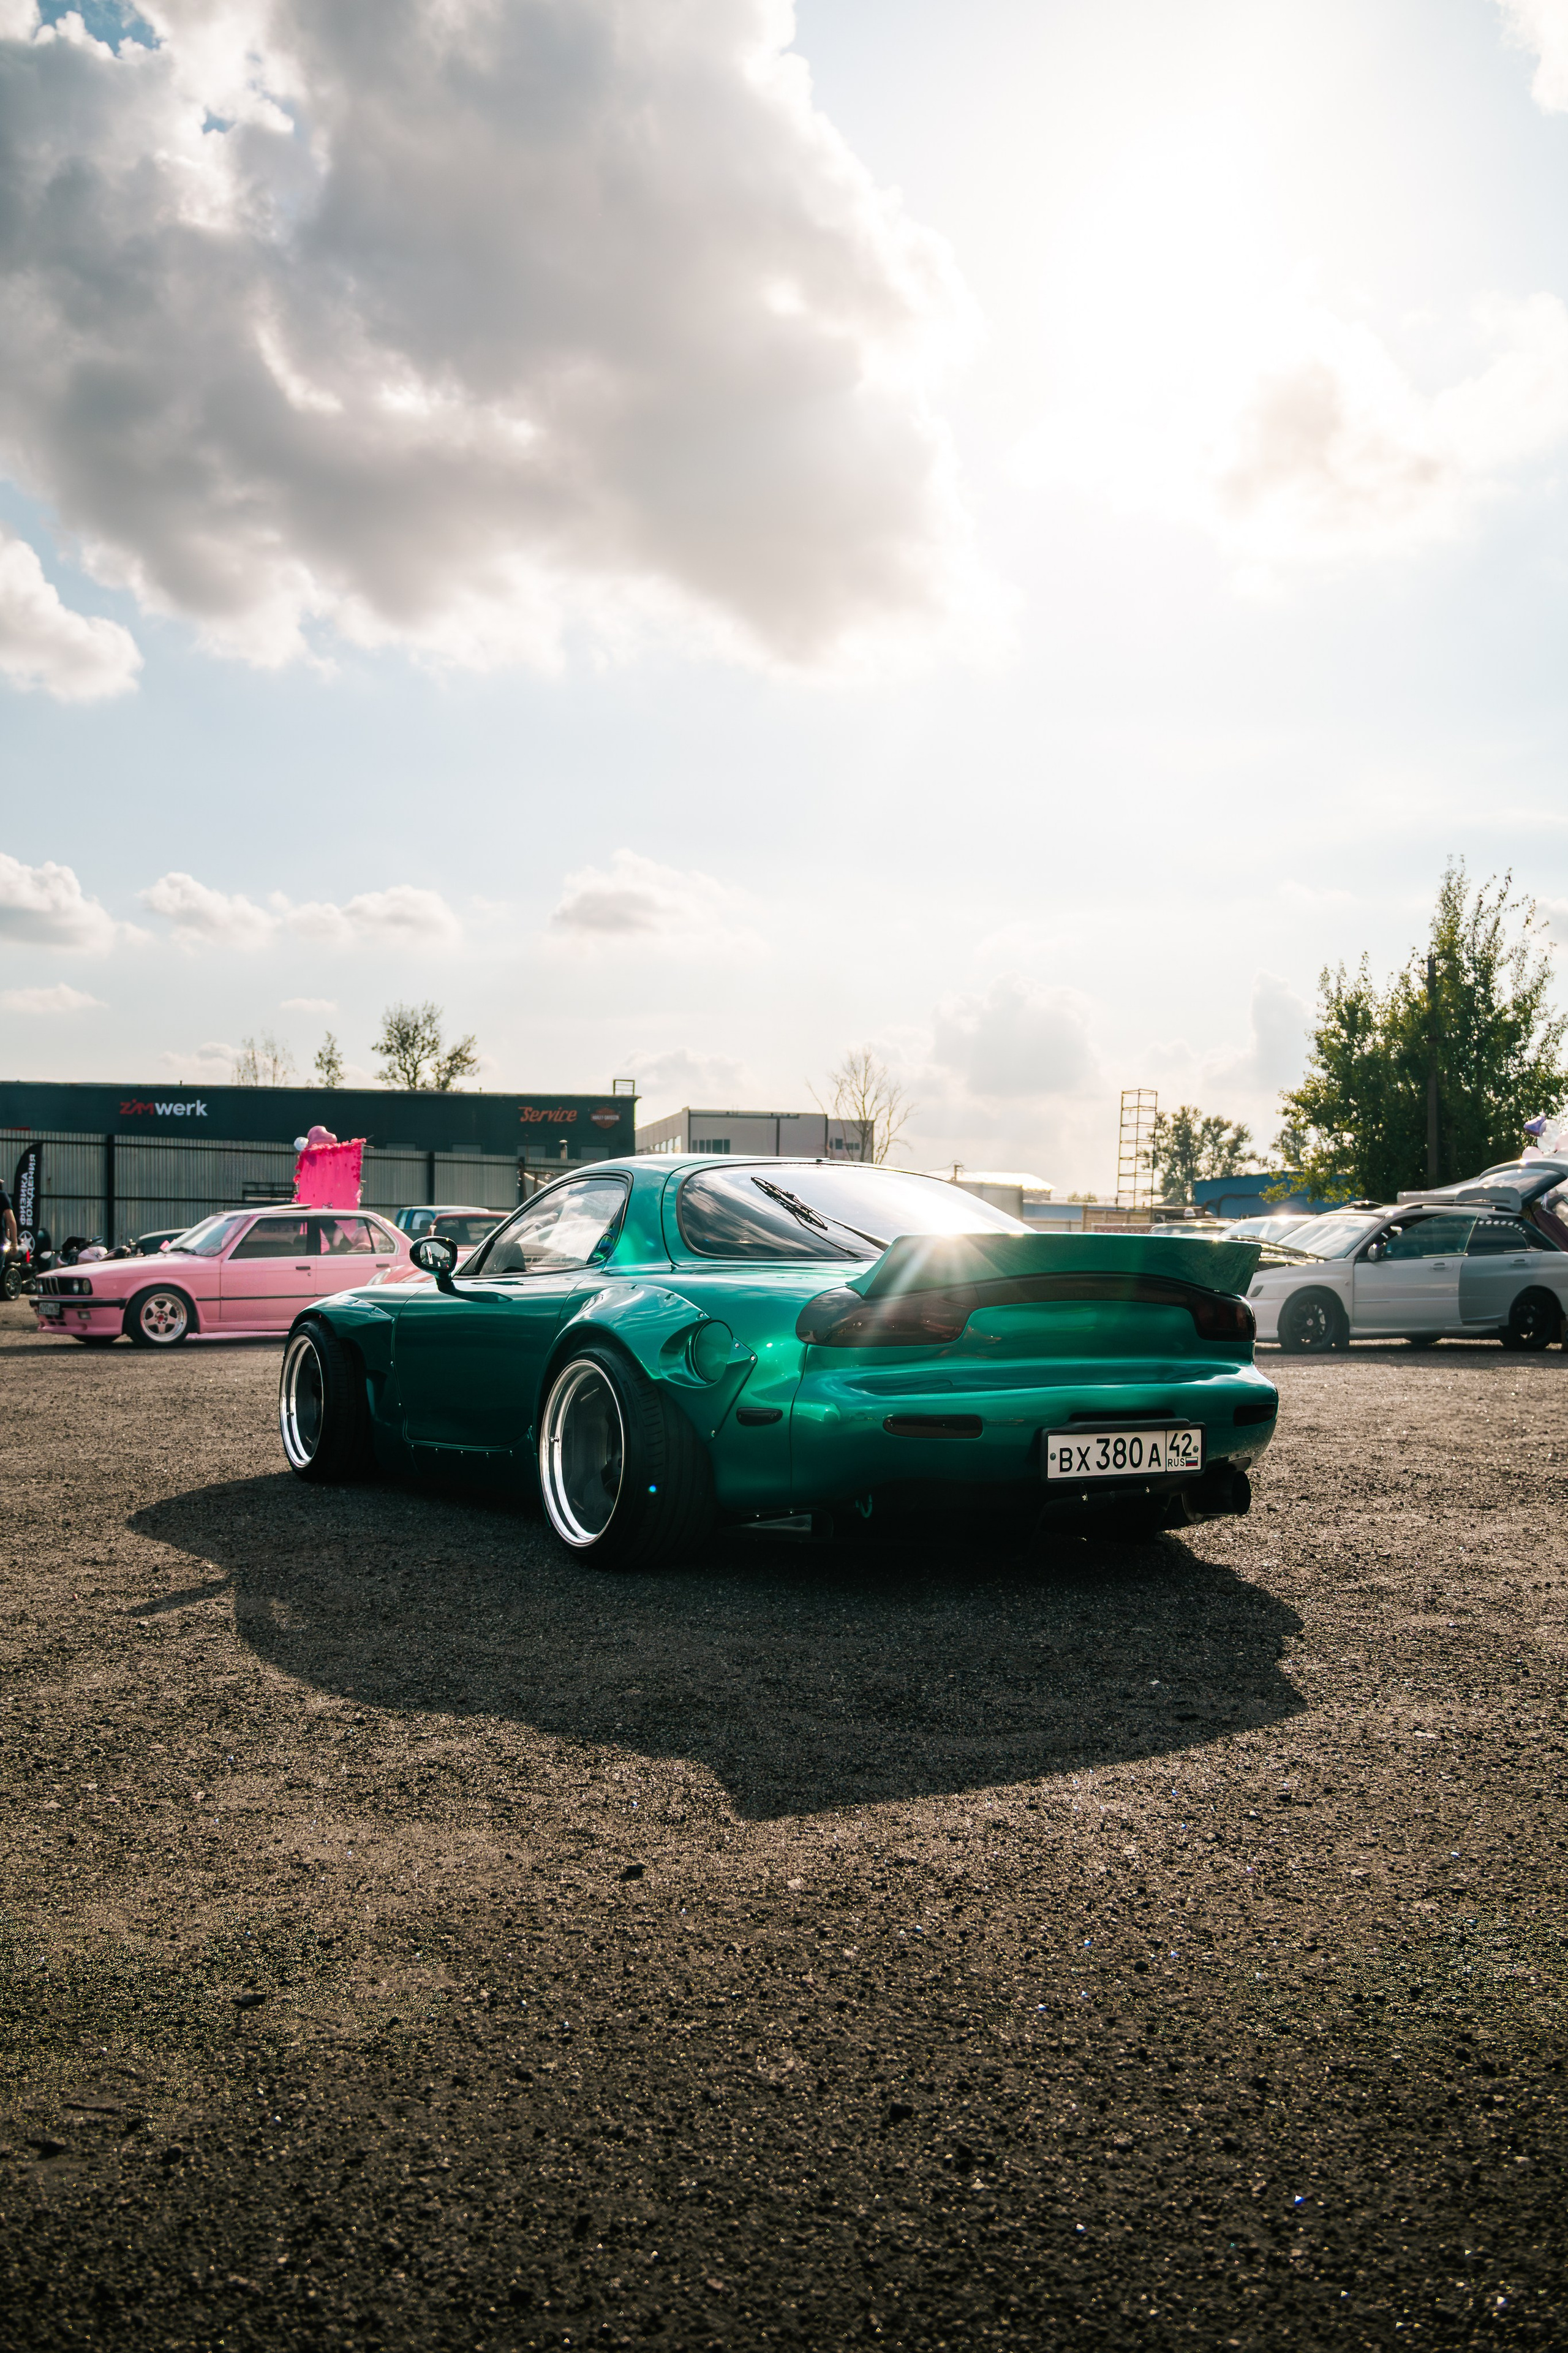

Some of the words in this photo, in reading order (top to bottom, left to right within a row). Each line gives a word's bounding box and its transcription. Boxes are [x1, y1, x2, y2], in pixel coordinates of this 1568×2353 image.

[518, 1106, 578, 1122] Service
[19, 1172, 29, 1225] ФИЗИКА
[26, 1154, 36, 1226] ВОЖДЕНИЯ
[1169, 1432, 1193, 1457] 42
[1167, 1458, 1185, 1468] RUS
